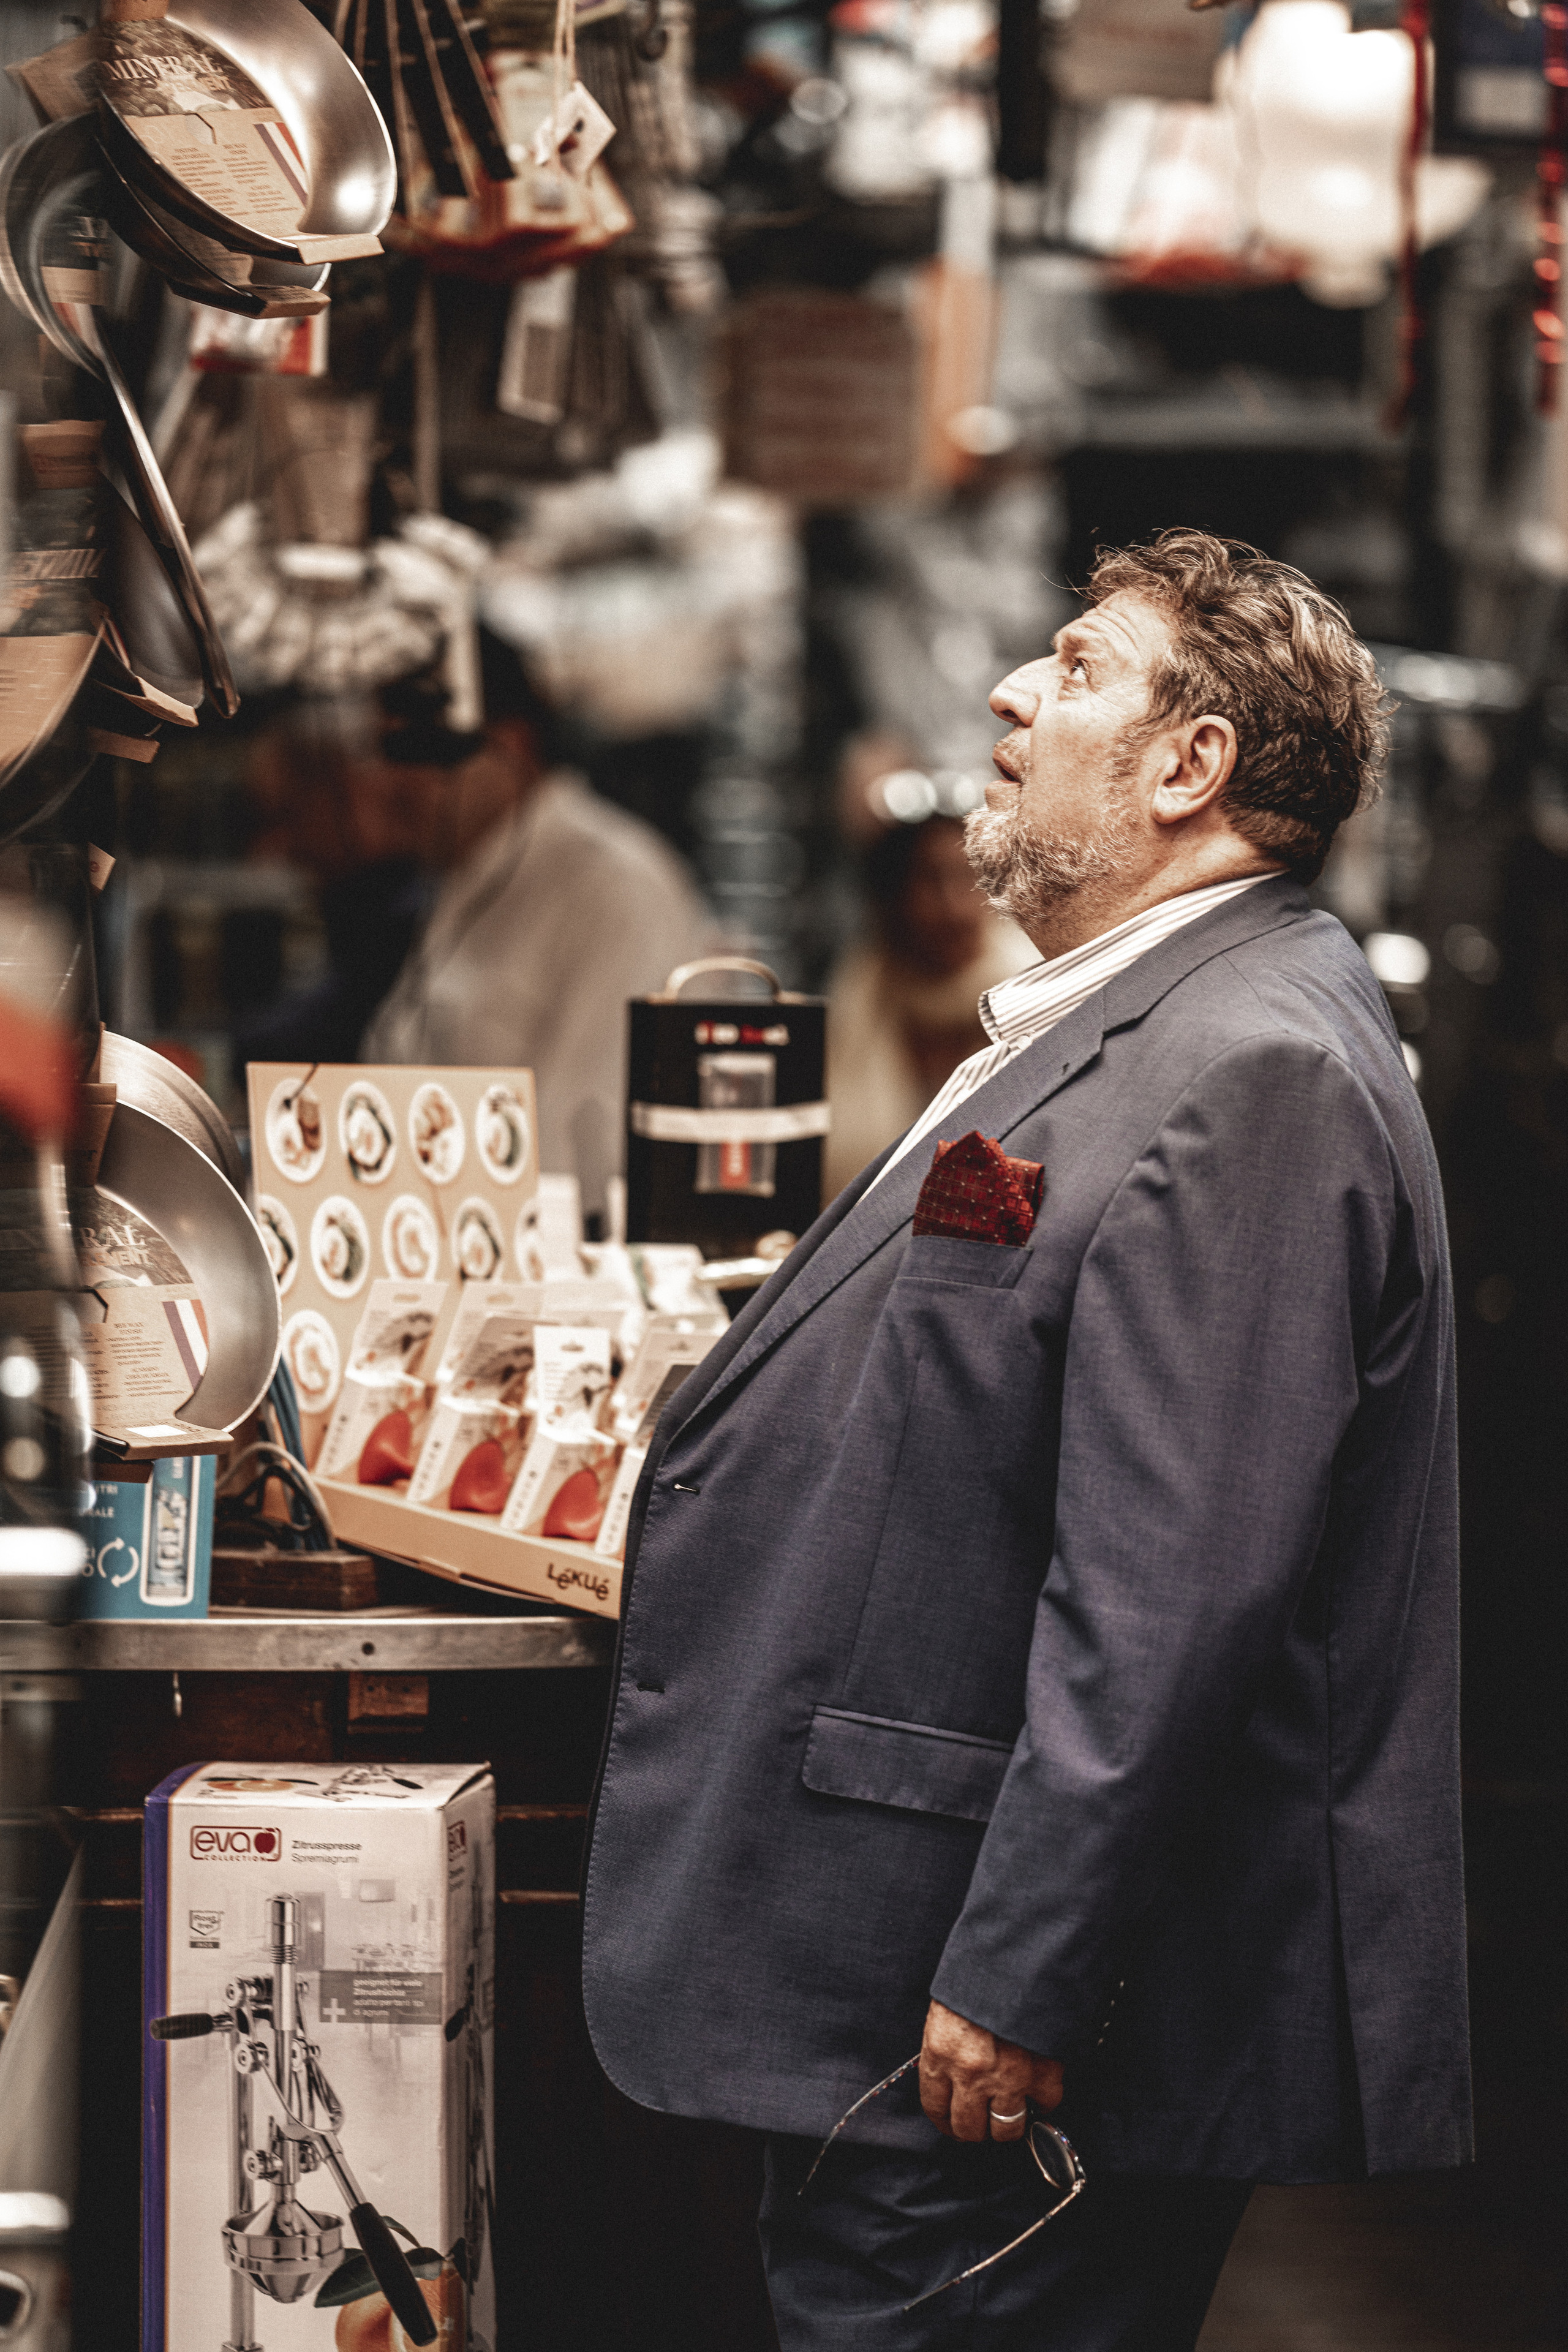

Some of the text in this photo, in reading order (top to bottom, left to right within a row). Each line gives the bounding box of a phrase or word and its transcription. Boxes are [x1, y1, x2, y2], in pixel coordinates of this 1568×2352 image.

[104, 53, 224, 80] MINERAL
[195, 1831, 251, 1853] eva
[292, 1839, 363, 1851] Zitrusspresse
[292, 1852, 360, 1865] Spremiagrumi
